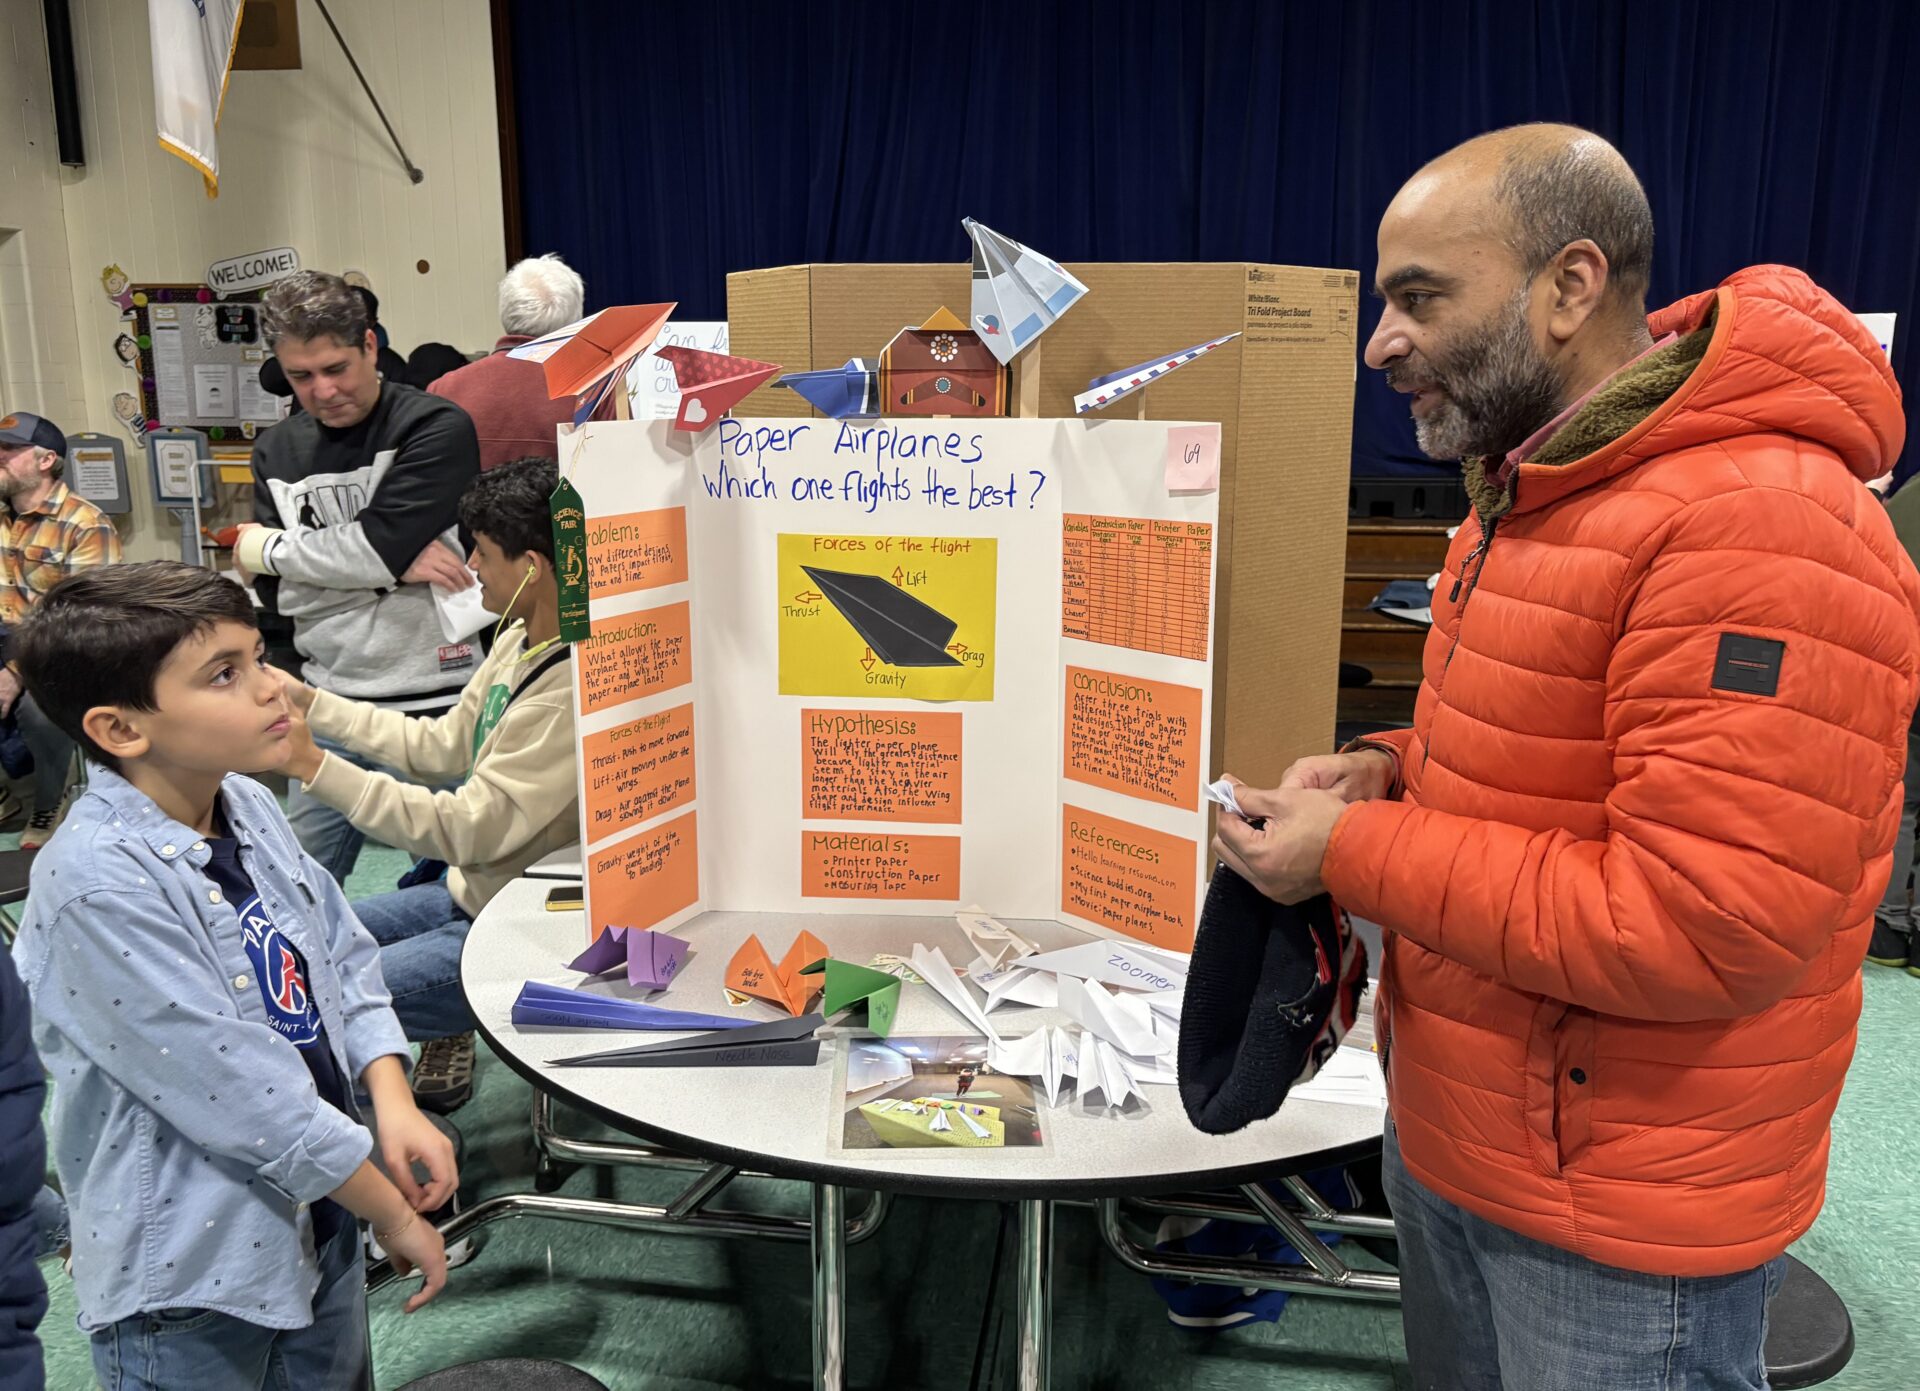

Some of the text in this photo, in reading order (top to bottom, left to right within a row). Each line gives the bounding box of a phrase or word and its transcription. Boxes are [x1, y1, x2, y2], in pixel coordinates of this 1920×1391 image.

[211, 253, 294, 285] WELCOME!
[1248, 307, 1311, 318] Tri Fold Project Board
[719, 420, 983, 471] Paper Airplanes
[1184, 444, 1200, 464] 69
[702, 460, 776, 500] Which
[792, 477, 834, 501] one
[839, 471, 911, 512] flights
[922, 467, 960, 506] the
[554, 507, 583, 522] SCIENCE
[561, 520, 577, 529] FAIR
[1154, 522, 1181, 533] Printer
[814, 537, 972, 556] Forces of the flight
[907, 570, 928, 587] Lift
[782, 605, 821, 617] Thrust
[586, 649, 615, 666] What
[620, 644, 646, 658] allows
[963, 651, 985, 668] Drag
[622, 658, 630, 668] to
[587, 678, 599, 689] the
[604, 675, 615, 684] air
[865, 672, 907, 688] Gravity
[1075, 693, 1187, 728] After three trials with
[812, 713, 916, 738] Hypothesis:
[1074, 701, 1111, 718] different
[1146, 720, 1154, 728] of
[1159, 724, 1186, 736] papers
[1151, 731, 1163, 740] out
[811, 737, 828, 747] The
[835, 738, 870, 750] lighter
[876, 739, 904, 750] paper
[816, 755, 852, 765] because
[859, 757, 890, 769] lighter
[845, 748, 958, 761] fly the greatest distance
[812, 774, 837, 784] longer
[844, 774, 864, 785] than
[869, 776, 885, 785] the
[852, 766, 861, 775] to
[871, 768, 895, 777] stay
[915, 768, 930, 777] the
[933, 771, 948, 779] air
[811, 793, 837, 804] shape
[841, 792, 857, 802] and
[902, 787, 919, 796] the
[813, 835, 909, 854] Materials:
[1071, 821, 1159, 864] References:
[833, 855, 870, 867] Printer
[1077, 846, 1098, 862] Hello
[830, 867, 941, 884] Construction Paper
[884, 880, 906, 891] Tape
[1075, 881, 1088, 896] My
[1090, 884, 1107, 899] first
[715, 1047, 793, 1062] Needle Nose
